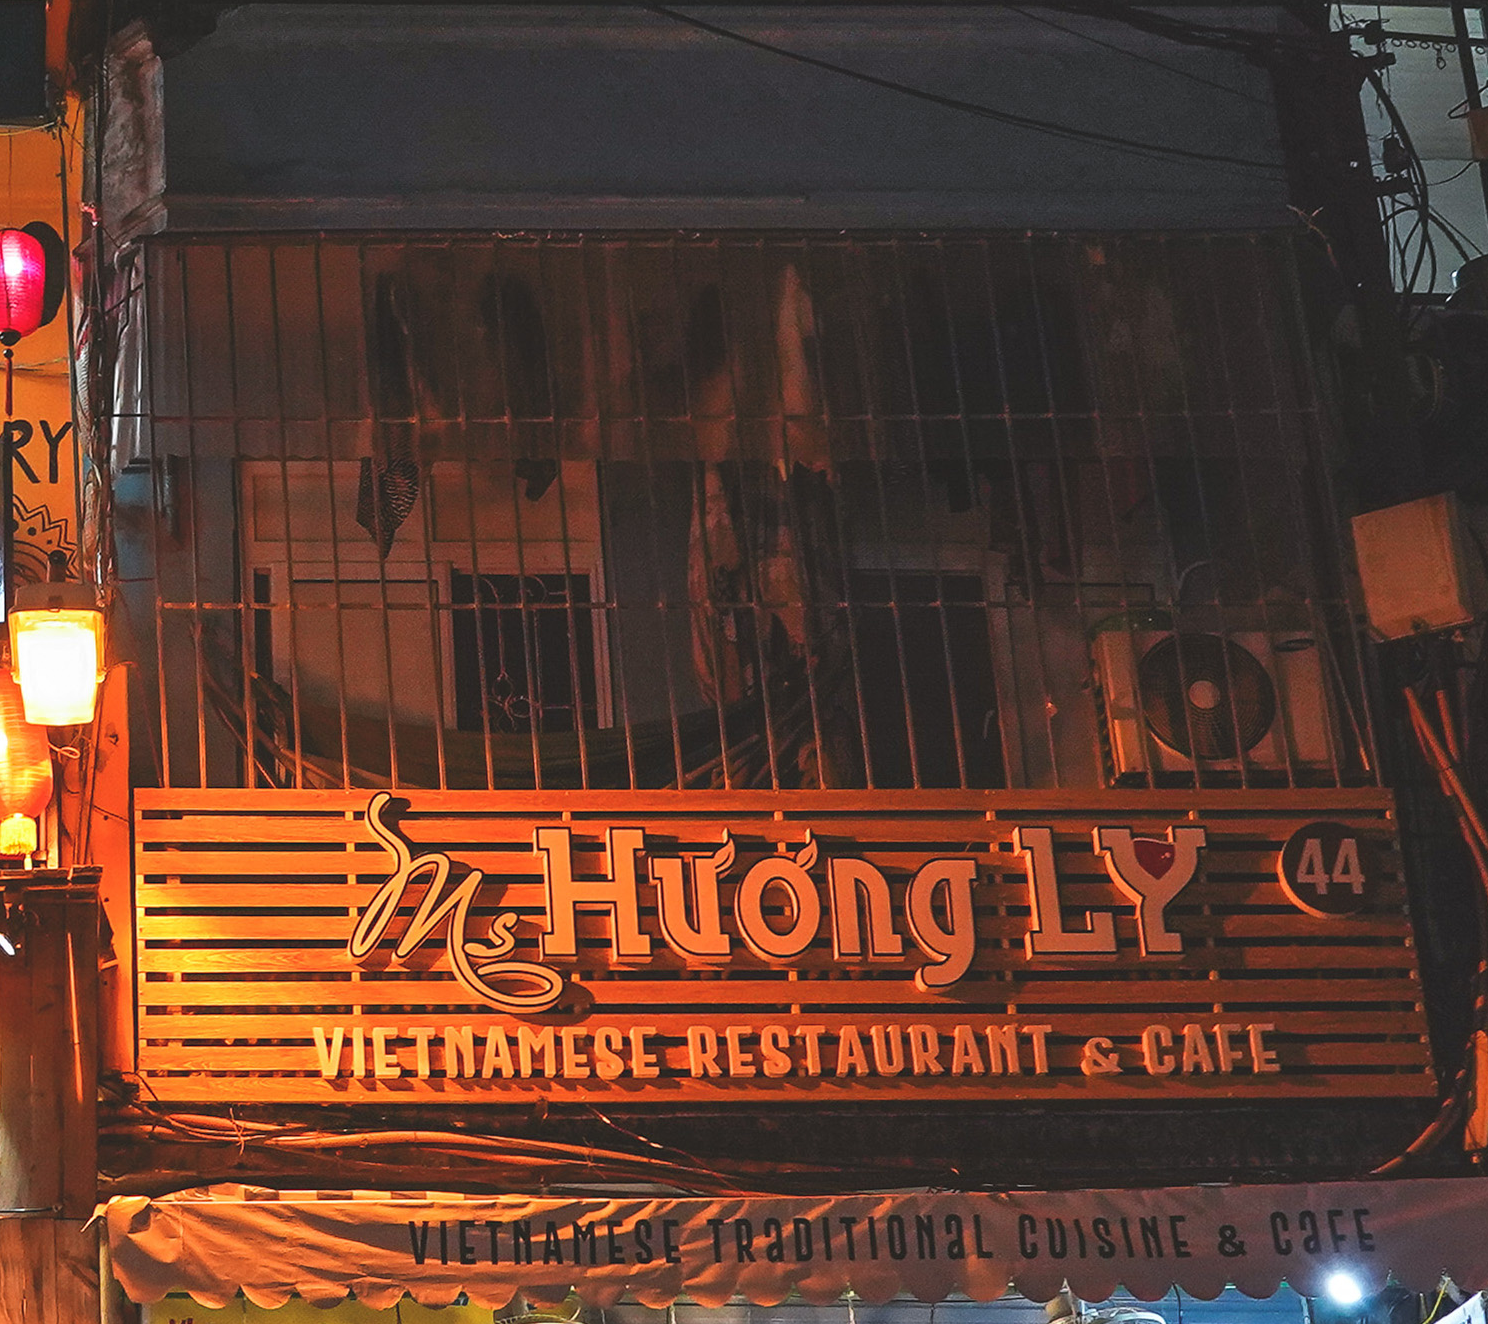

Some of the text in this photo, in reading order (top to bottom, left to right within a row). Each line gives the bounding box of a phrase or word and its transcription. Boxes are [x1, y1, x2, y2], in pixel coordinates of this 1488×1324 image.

[1297, 838, 1366, 895] 44
[346, 791, 565, 1014] Ms
[1013, 826, 1207, 959] LY
[313, 1022, 1281, 1079] VIETNAMESE RESTAURANT & CAFE
[408, 1218, 683, 1266] VIETNAMESE
[1018, 1213, 1192, 1261] CUISINE
[1217, 1224, 1247, 1258] &
